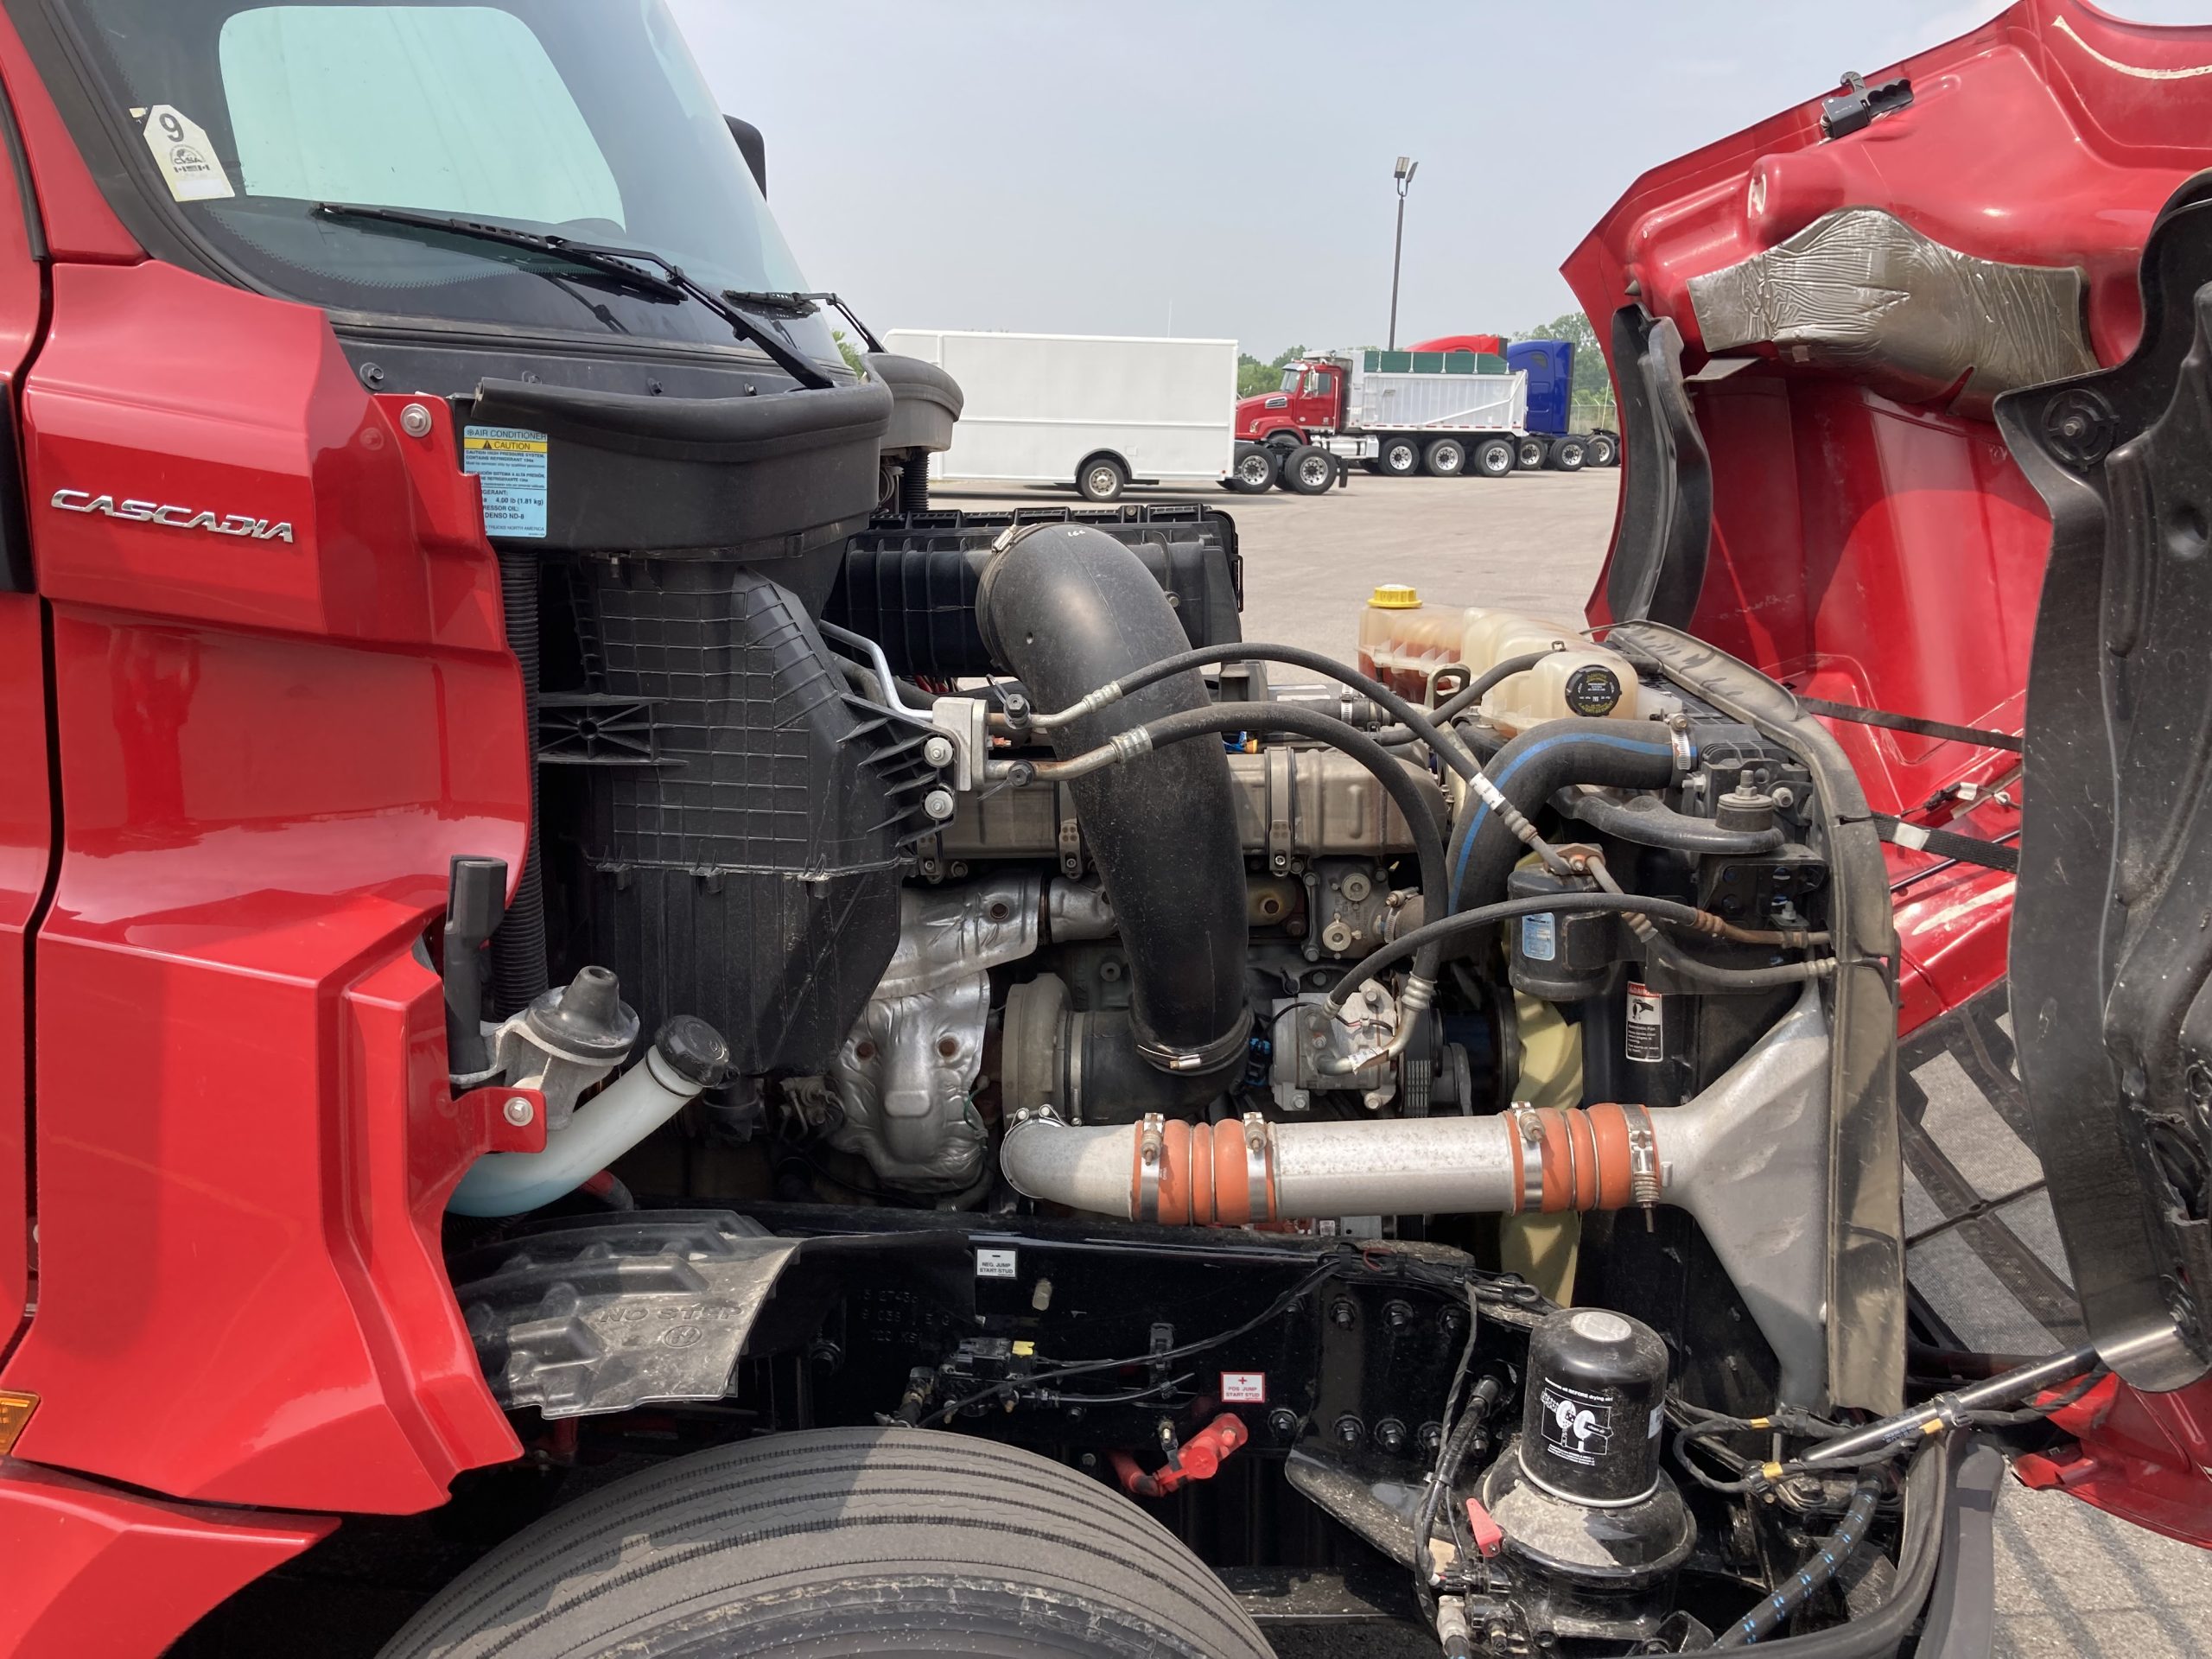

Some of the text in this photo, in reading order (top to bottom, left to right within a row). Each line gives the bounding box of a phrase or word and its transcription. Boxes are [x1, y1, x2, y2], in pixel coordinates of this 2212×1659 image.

[159, 113, 184, 143] 9
[490, 430, 546, 440] CONDITIONER
[51, 489, 293, 543] CASCADIA
[600, 1306, 743, 1323] NO STEP
